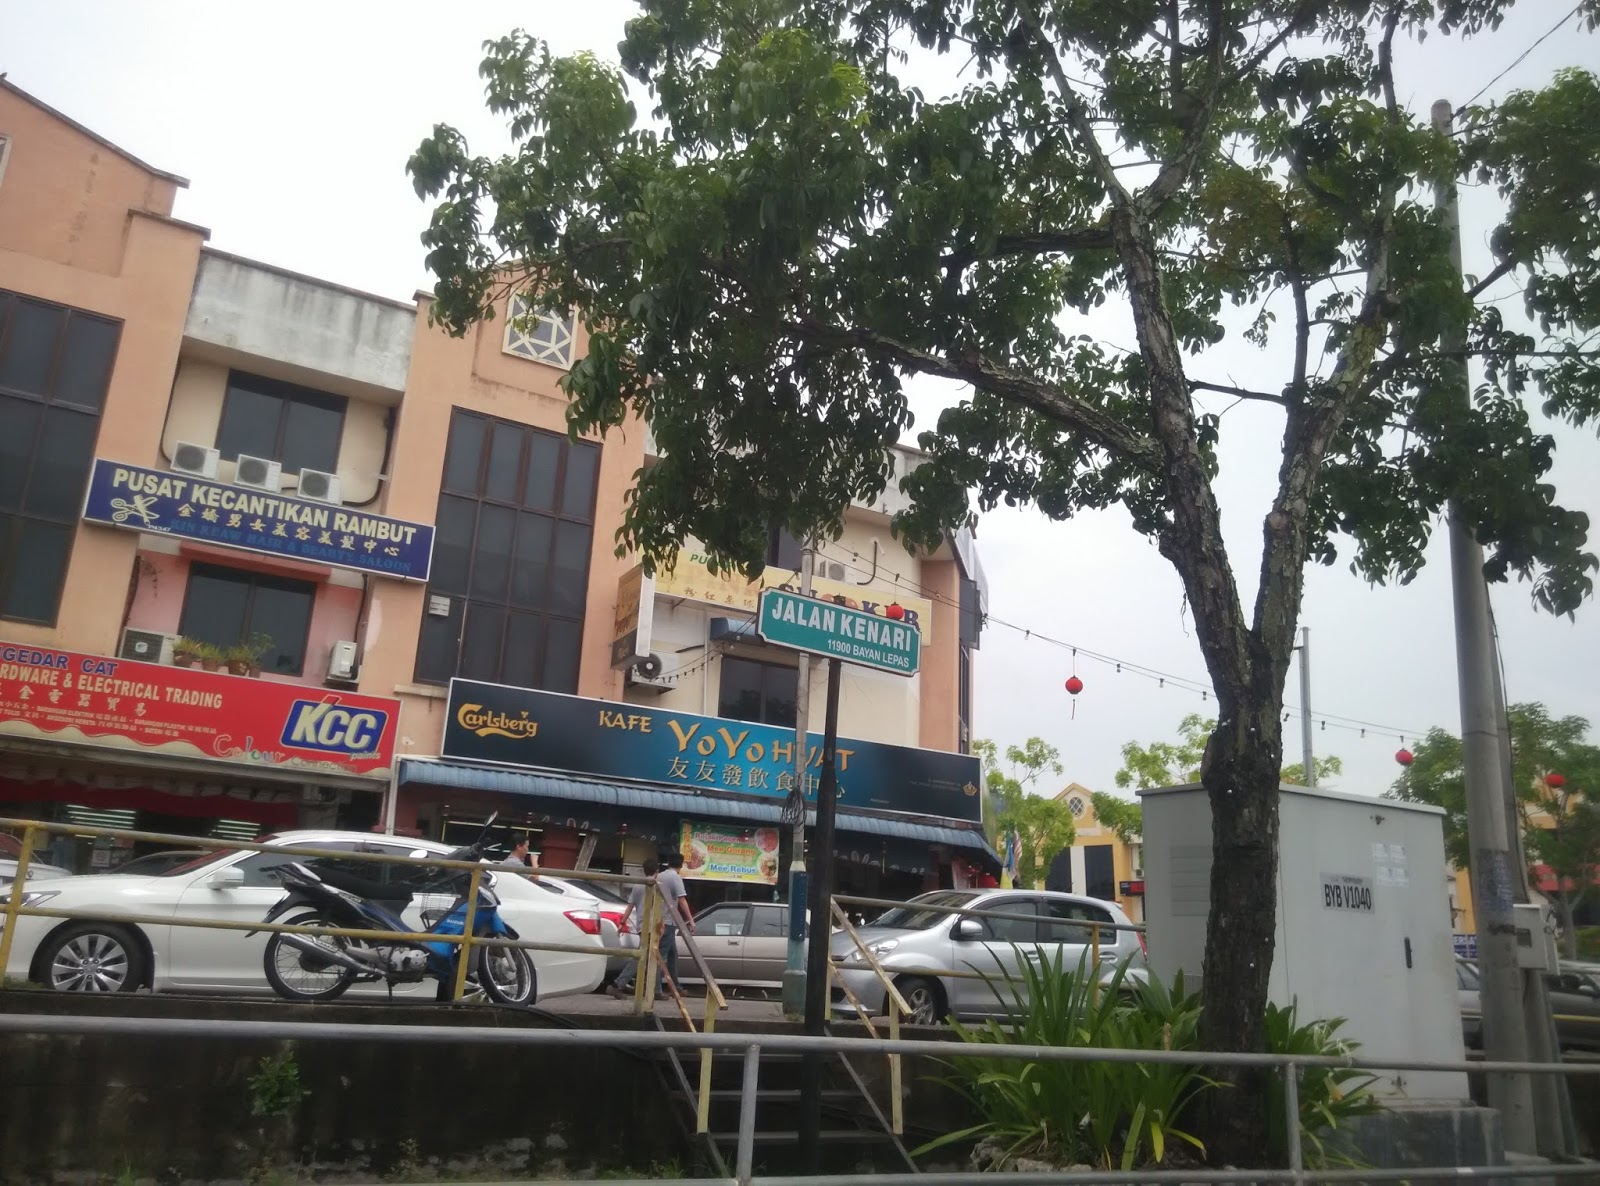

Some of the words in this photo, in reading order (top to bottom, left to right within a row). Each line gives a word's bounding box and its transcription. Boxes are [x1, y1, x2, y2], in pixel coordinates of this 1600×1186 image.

[113, 468, 187, 500] PUSAT
[191, 484, 329, 529] KECANTIKAN
[333, 512, 416, 545] RAMBUT
[772, 597, 836, 633] JALAN
[840, 614, 911, 652] KENARI
[82, 659, 119, 677] CAT
[828, 639, 850, 654] 11900
[853, 644, 881, 663] BAYAN
[882, 653, 909, 669] LEPAS
[0, 683, 147, 716] 金電器貿易
[62, 672, 73, 688] &
[77, 674, 160, 701] ELECTRICAL
[165, 686, 223, 709] TRADING
[290, 696, 377, 749] KCC
[457, 703, 538, 739] Carlsberg
[600, 710, 652, 733] KAFE
[213, 734, 285, 764] Colour
[350, 750, 382, 762] paints
[710, 864, 728, 872] Mee
[730, 866, 757, 874] Rebus
[1324, 884, 1342, 908] BYB
[1343, 885, 1372, 910] V1040
